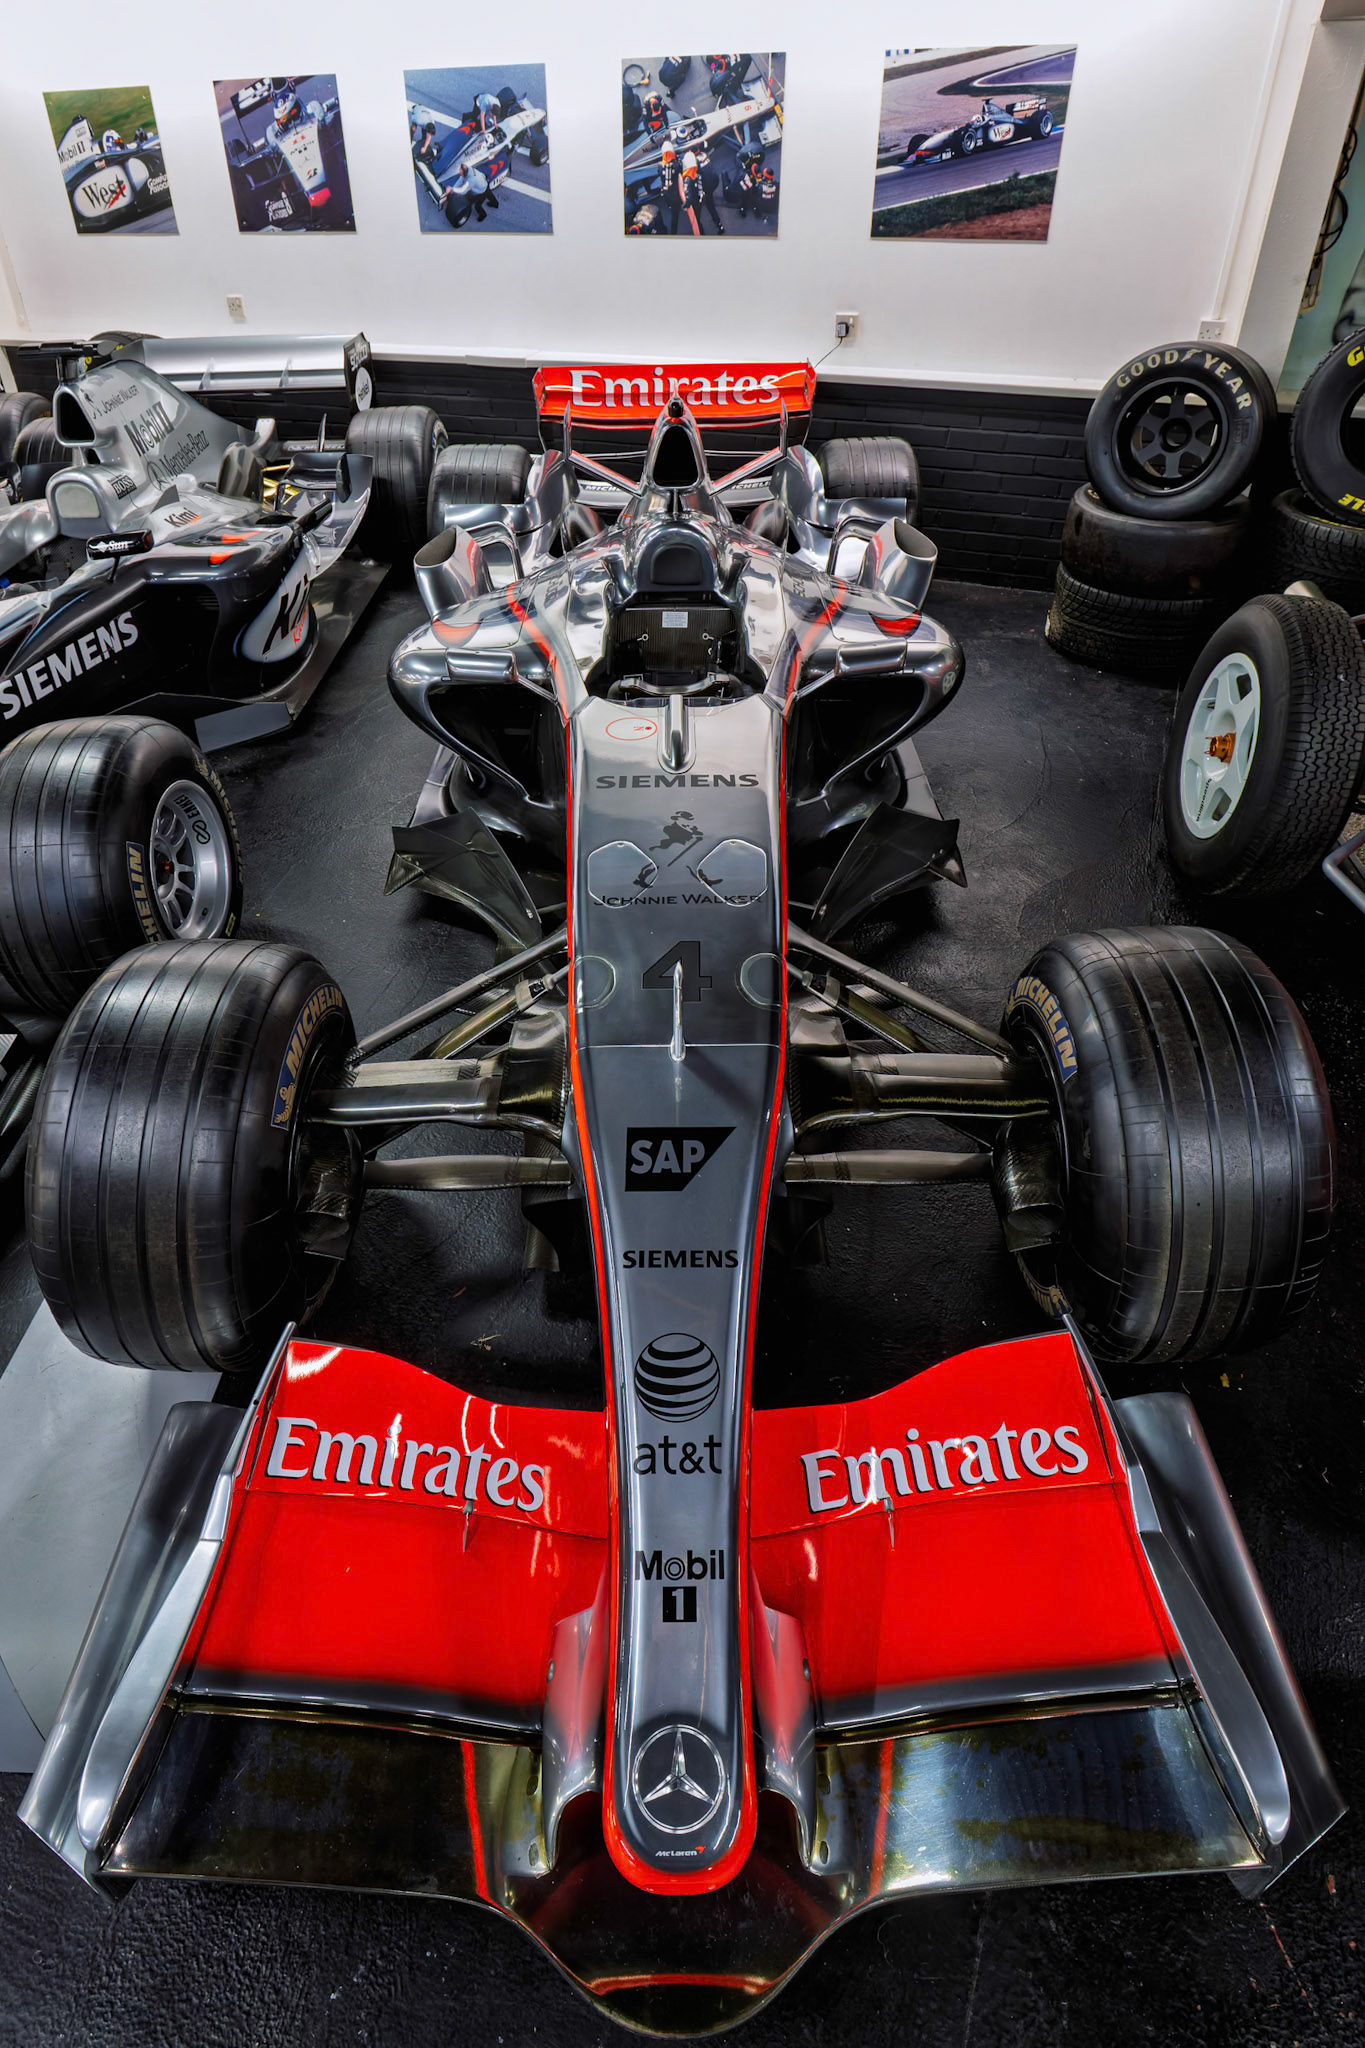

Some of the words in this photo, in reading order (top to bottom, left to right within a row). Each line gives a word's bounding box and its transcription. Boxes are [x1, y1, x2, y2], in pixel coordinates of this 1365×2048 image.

[58, 147, 78, 163] Mobil
[81, 174, 127, 209] West
[568, 367, 781, 407] Emirates
[124, 409, 166, 457] Mobil
[160, 430, 210, 479] Mercedes-Benz
[113, 476, 136, 495] BOSS
[164, 507, 199, 528] Kimi
[108, 540, 129, 551] Sun
[0, 611, 139, 720] SIEMENS
[596, 774, 760, 789] SIEMENS
[682, 893, 763, 905] WALKER
[641, 940, 713, 1003] 4
[286, 985, 343, 1079] MICHELIN
[1014, 976, 1078, 1069] MICHELIN
[630, 1139, 706, 1175] SAP
[622, 1250, 739, 1269] SIEMENS
[266, 1415, 545, 1512] Emirates
[633, 1434, 723, 1475] at&t
[800, 1421, 1089, 1513] Emirates
[634, 1549, 725, 1581] Mobil
